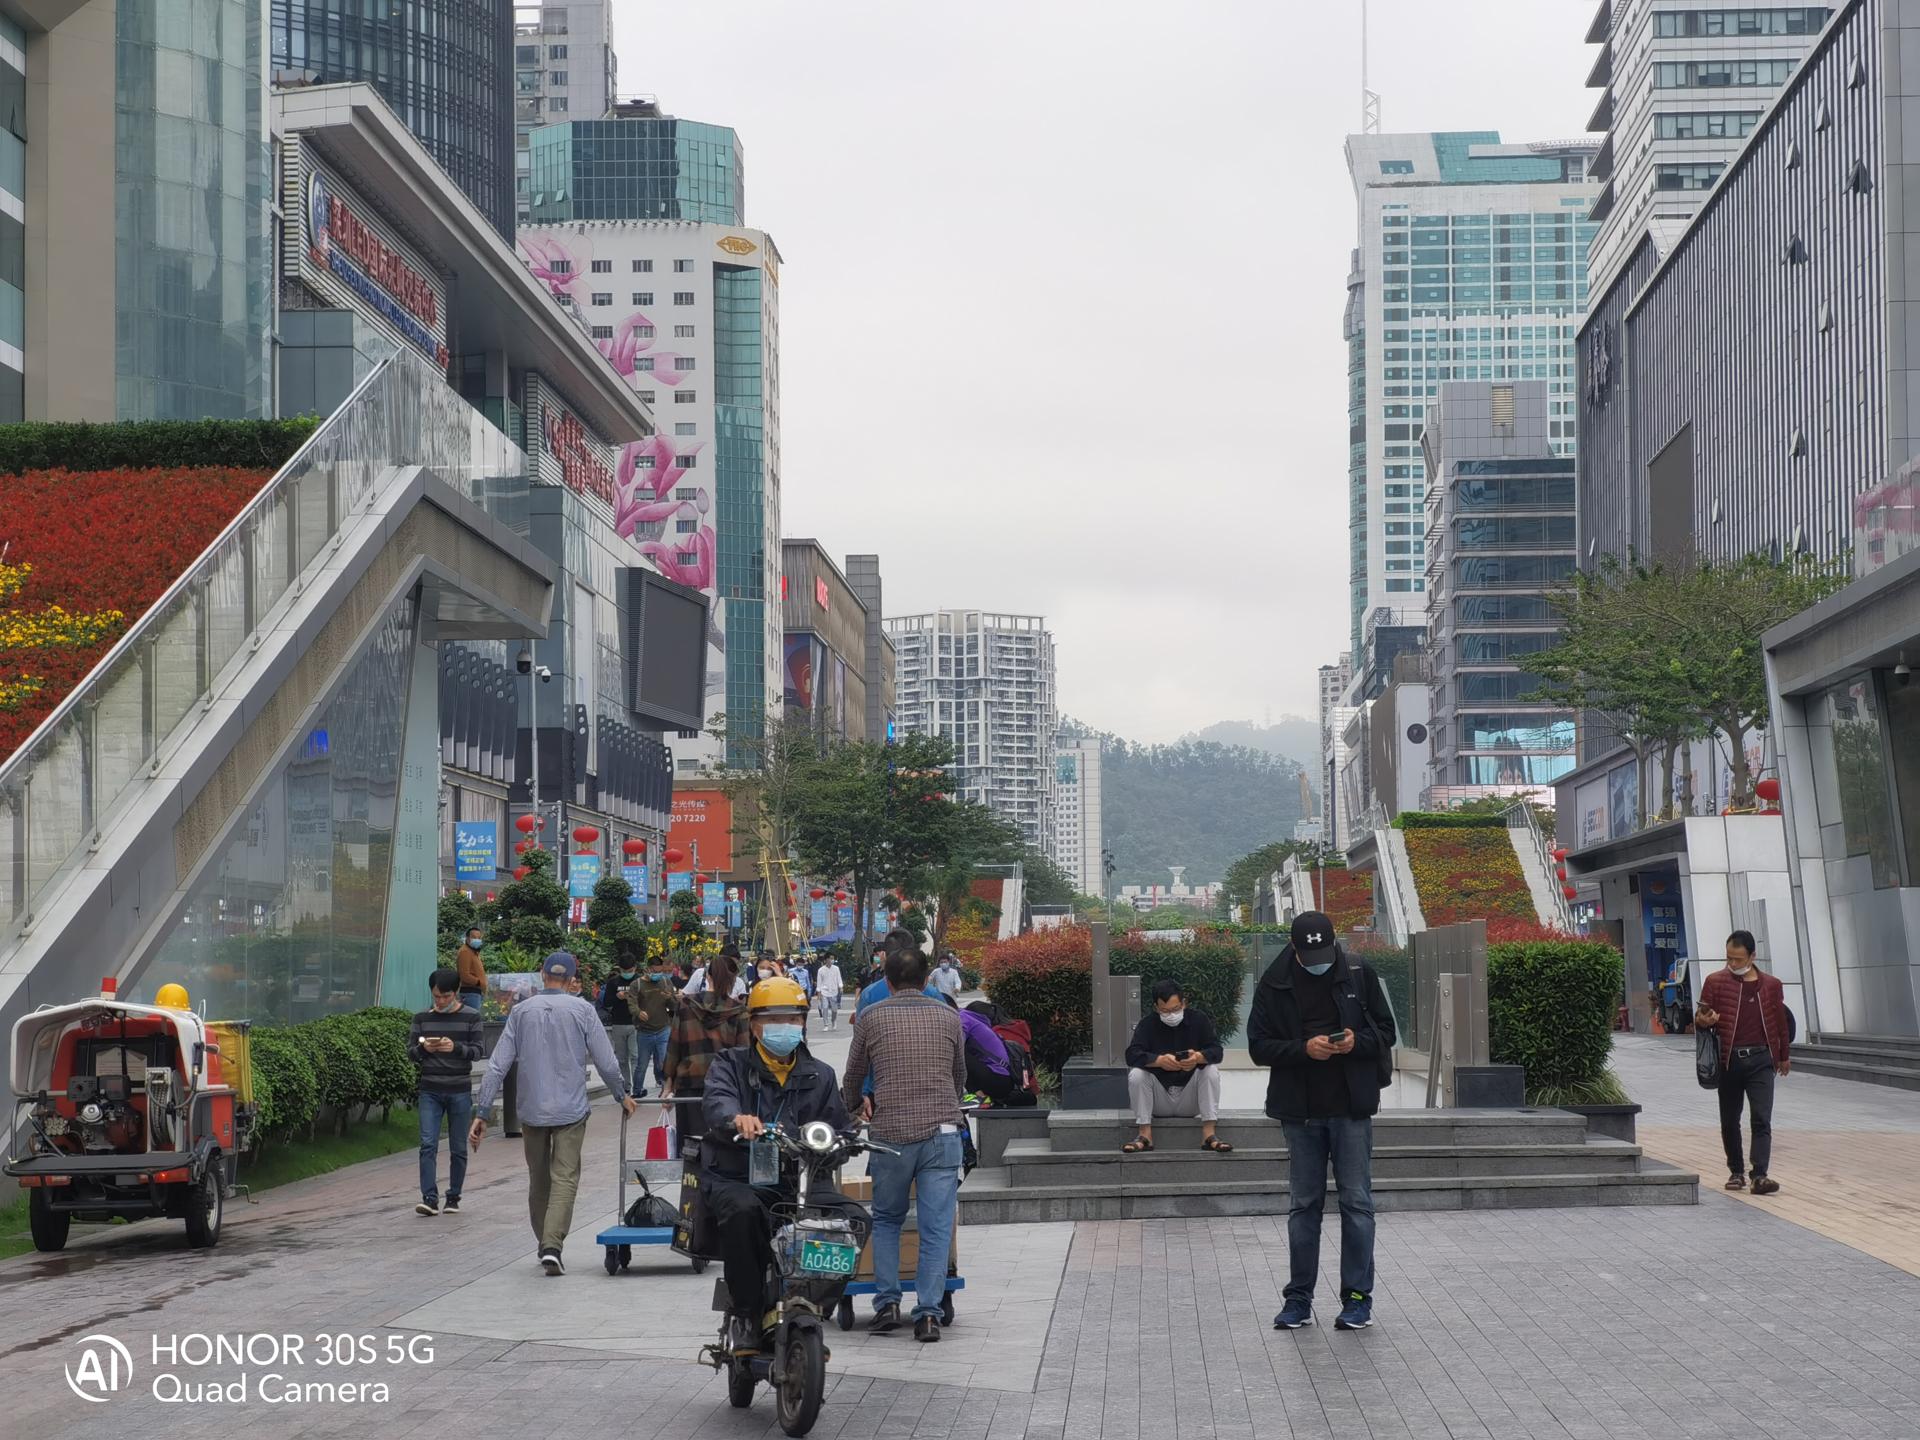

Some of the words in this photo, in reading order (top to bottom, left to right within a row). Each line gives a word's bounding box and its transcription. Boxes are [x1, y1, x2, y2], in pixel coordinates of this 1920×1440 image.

[684, 814, 706, 822] 7220
[1654, 923, 1678, 933] 自由
[1655, 938, 1679, 949] 爱国
[805, 1253, 850, 1271] A0486
